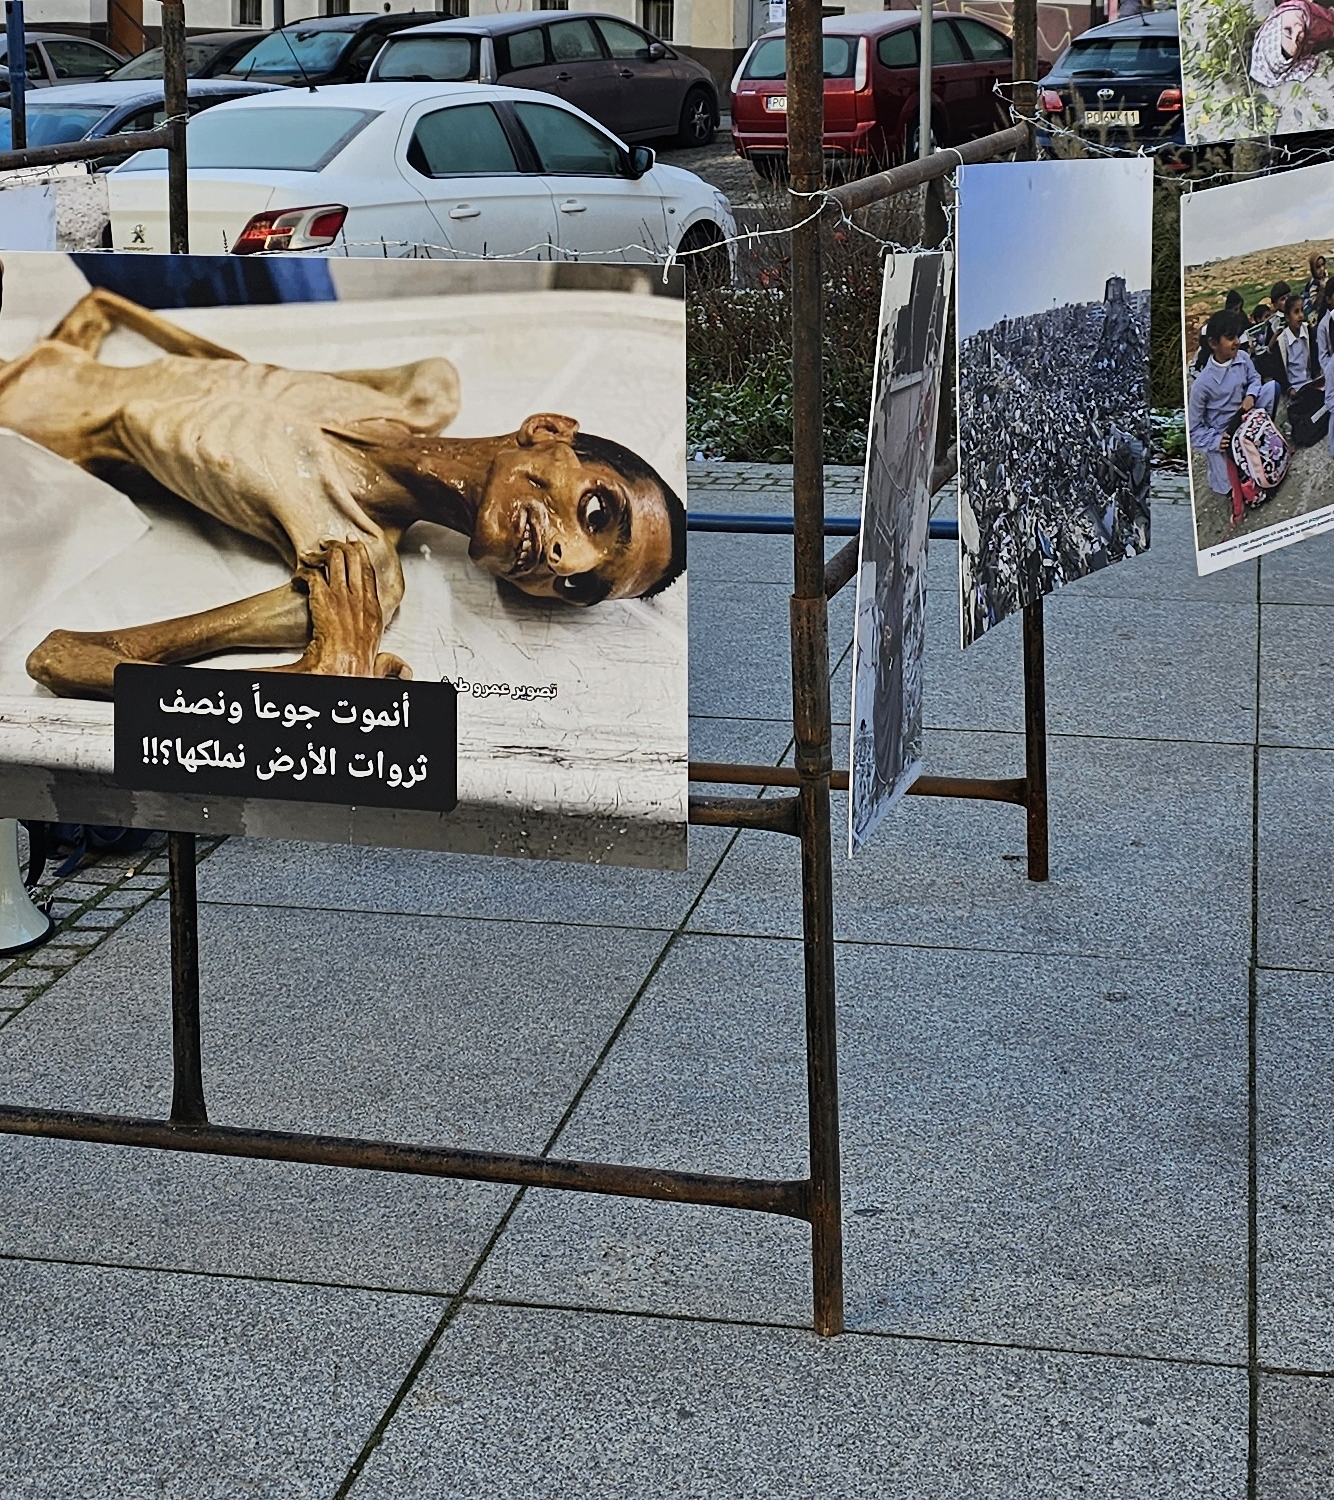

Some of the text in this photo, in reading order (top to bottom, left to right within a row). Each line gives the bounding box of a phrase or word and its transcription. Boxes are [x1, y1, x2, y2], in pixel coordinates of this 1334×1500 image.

[472, 683, 510, 698] عمرو
[511, 684, 557, 700] تصوير
[159, 683, 409, 732] أنموت جوعاً ونصف
[142, 736, 428, 788] ثروات الأرض نملكها؟!!
